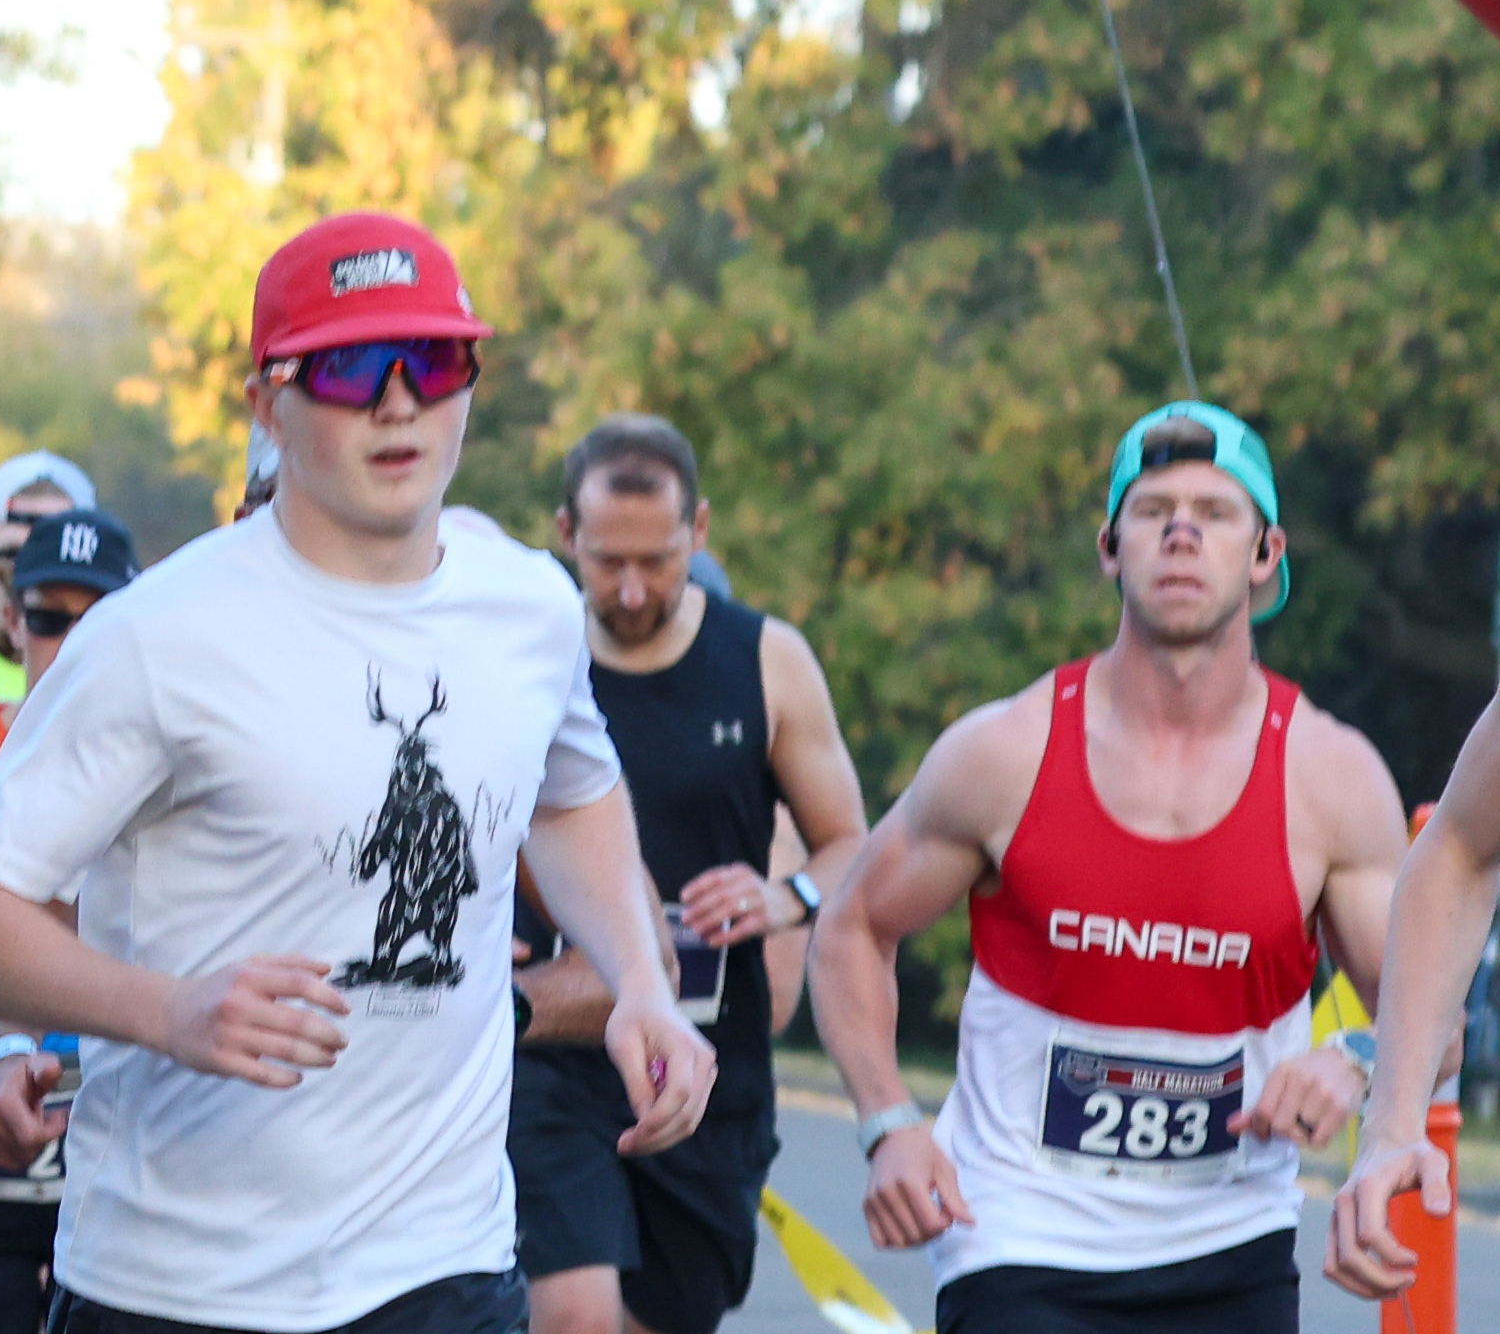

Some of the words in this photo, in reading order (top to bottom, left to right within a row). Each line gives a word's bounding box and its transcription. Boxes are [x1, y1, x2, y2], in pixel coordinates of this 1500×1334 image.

[1049, 908, 1252, 970] CANADA
[1131, 1068, 1161, 1091] HALF
[1163, 1070, 1225, 1094] MARATHON
[1078, 1090, 1211, 1160] 283
